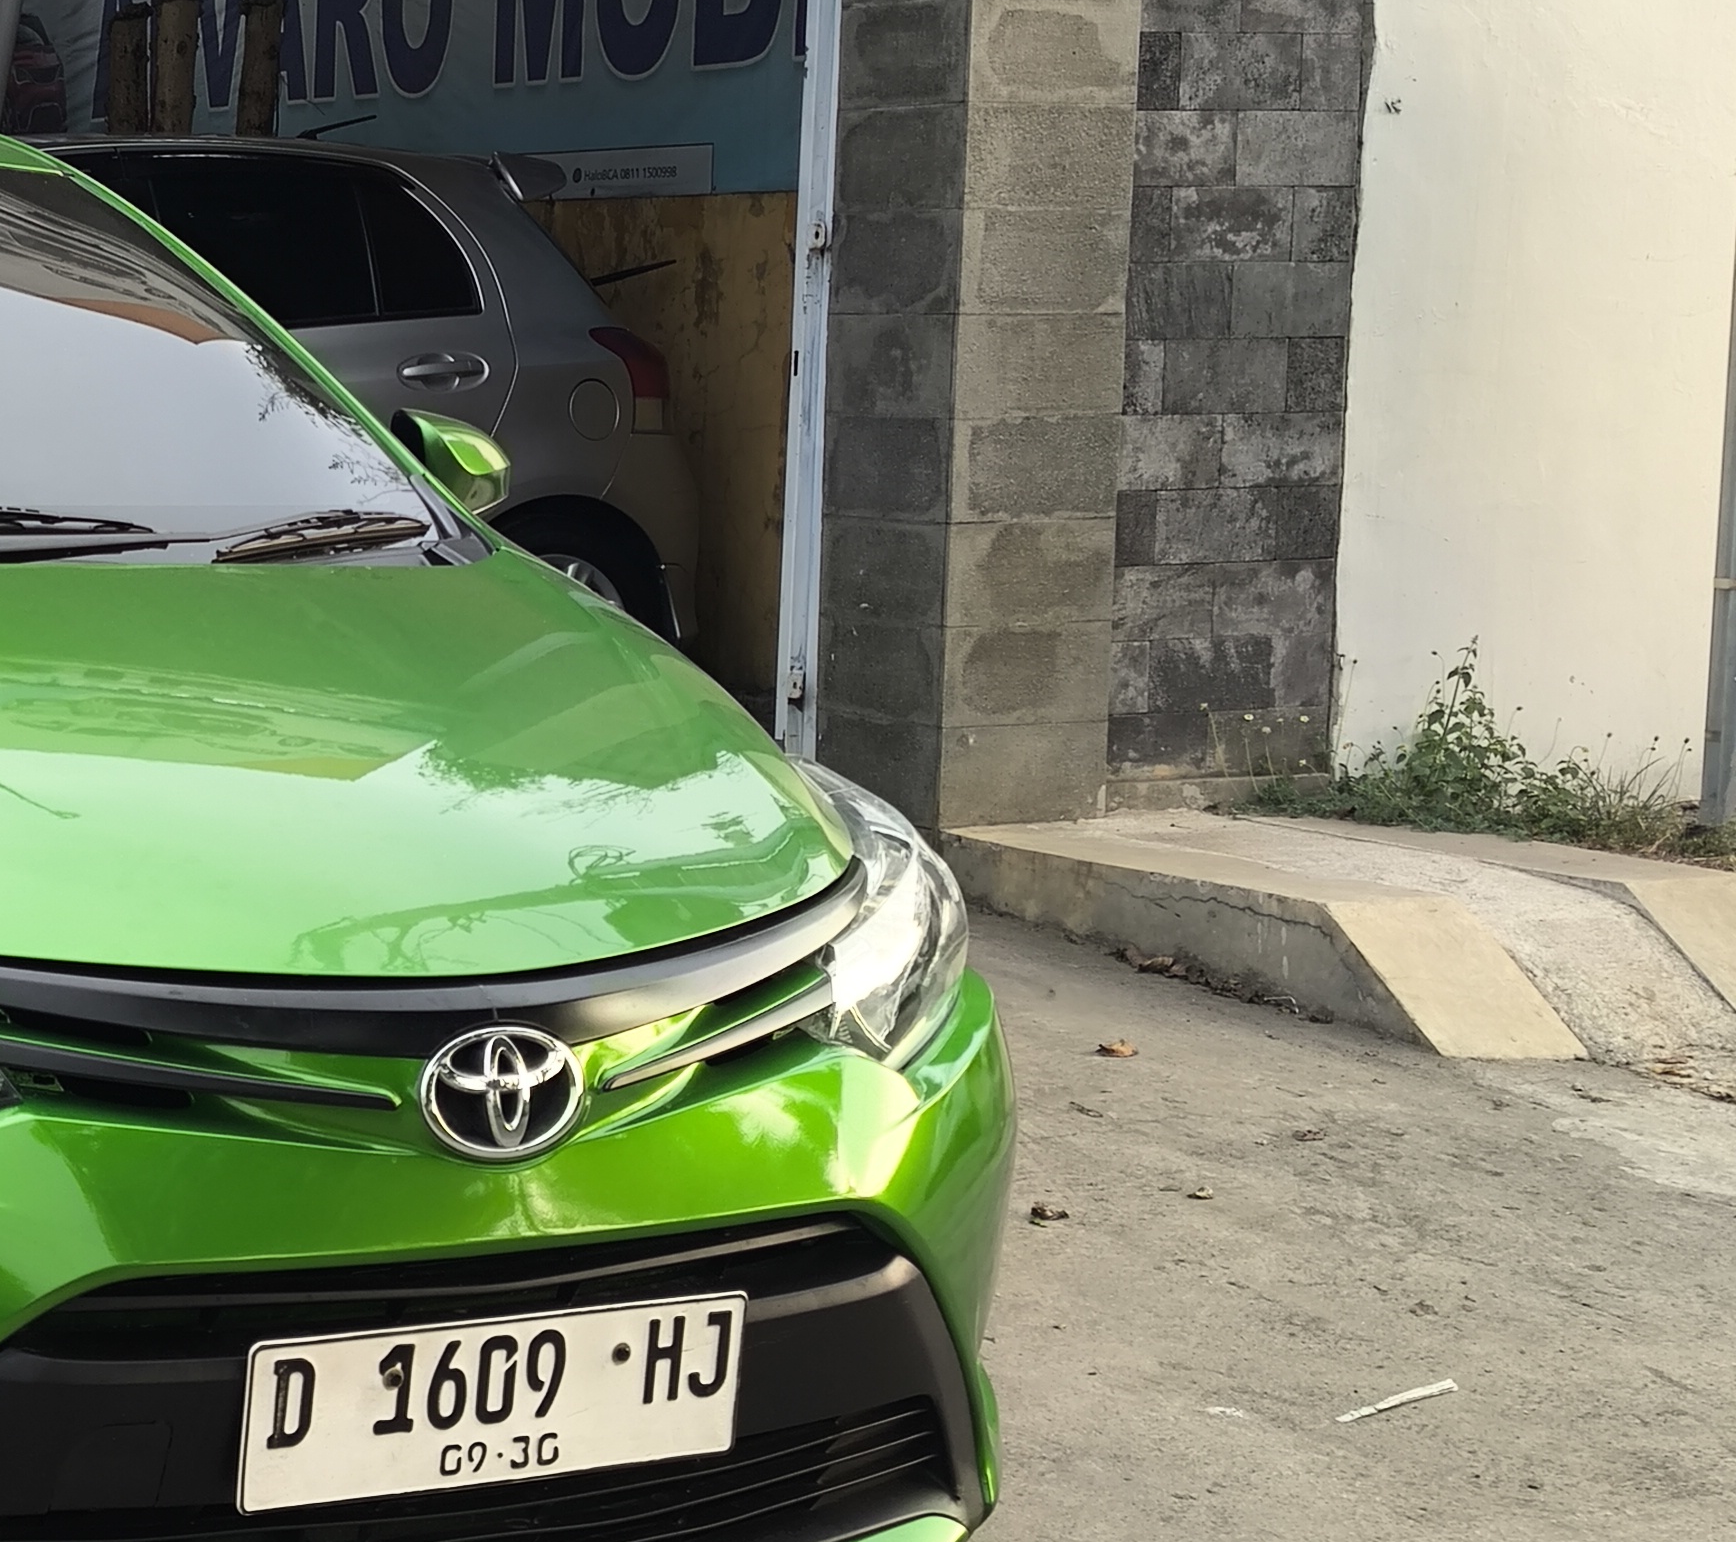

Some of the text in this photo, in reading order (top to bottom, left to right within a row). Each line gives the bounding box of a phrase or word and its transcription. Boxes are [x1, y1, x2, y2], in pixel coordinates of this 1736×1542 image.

[584, 166, 677, 182] HaloBCA 0811 1500998
[266, 1310, 733, 1449] D 1609 HJ
